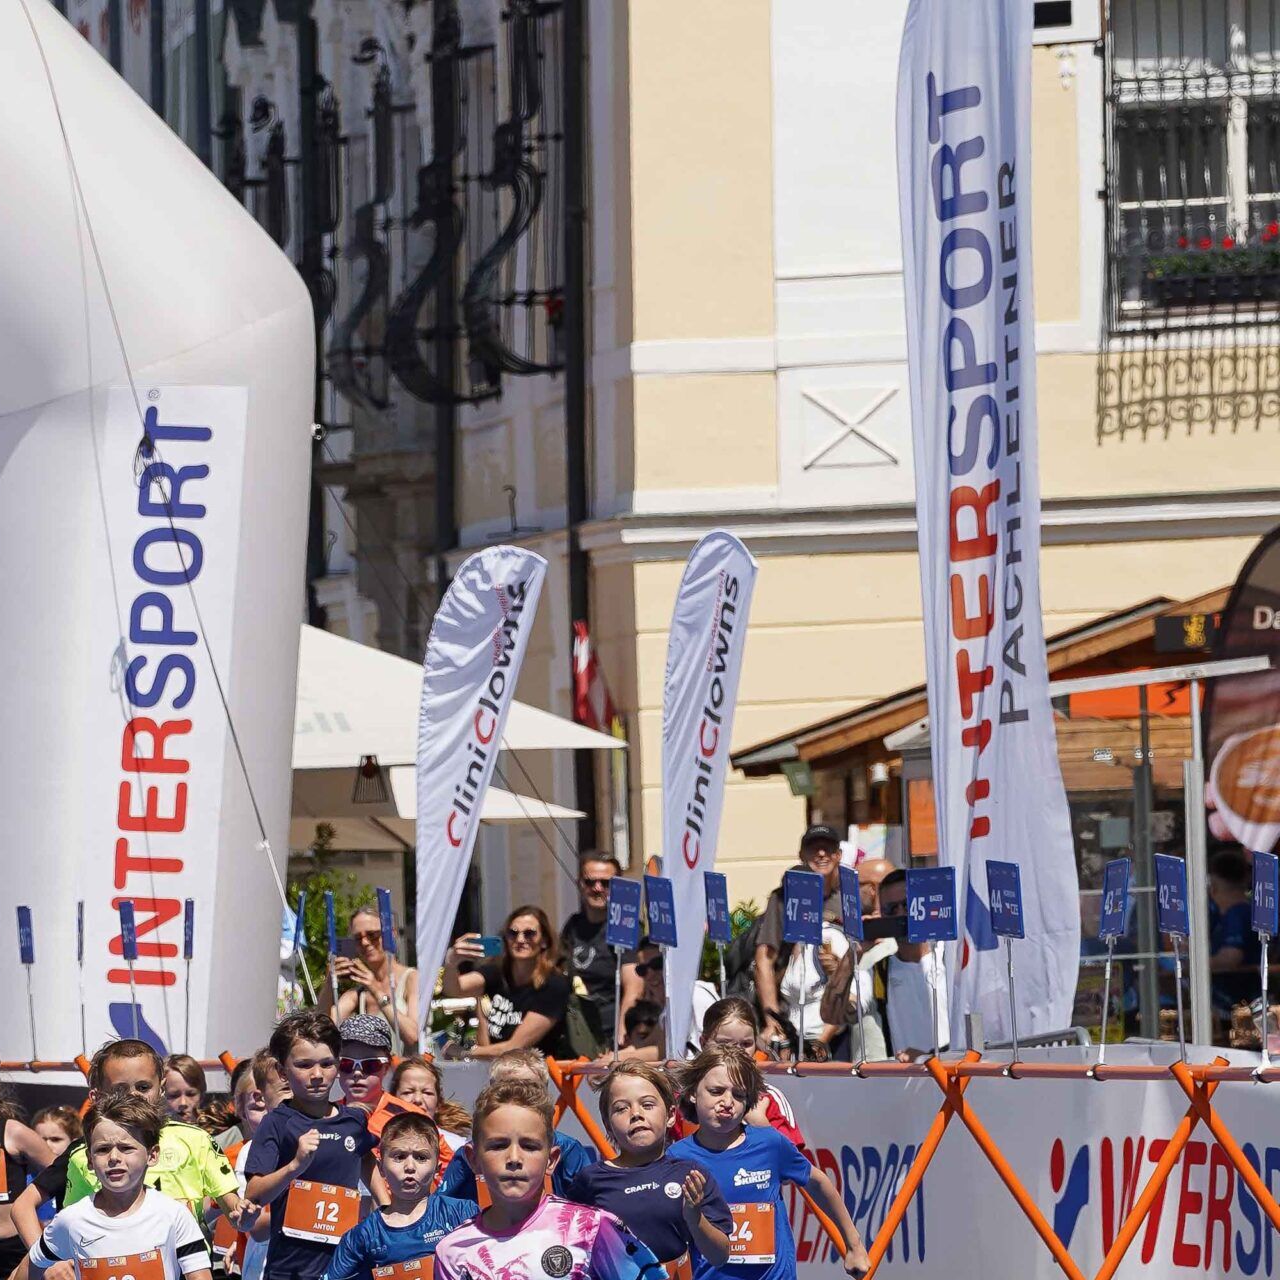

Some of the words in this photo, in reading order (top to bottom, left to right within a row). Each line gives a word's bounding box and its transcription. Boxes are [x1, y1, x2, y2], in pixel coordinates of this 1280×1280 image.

[997, 162, 1029, 725] PACHLEITNER
[107, 405, 212, 988] INTERSPORT
[446, 580, 526, 847] CliniClowns
[682, 573, 740, 870] CliniClowns
[786, 897, 800, 922] 47
[909, 896, 927, 921] 45
[991, 889, 1003, 914] 44
[1159, 884, 1170, 910] 42
[938, 906, 952, 919] AUT
[625, 1183, 652, 1195] CRAFT
[315, 1201, 339, 1223] 12
[313, 1222, 335, 1232] ANTON
[731, 1244, 746, 1252] LUIS
